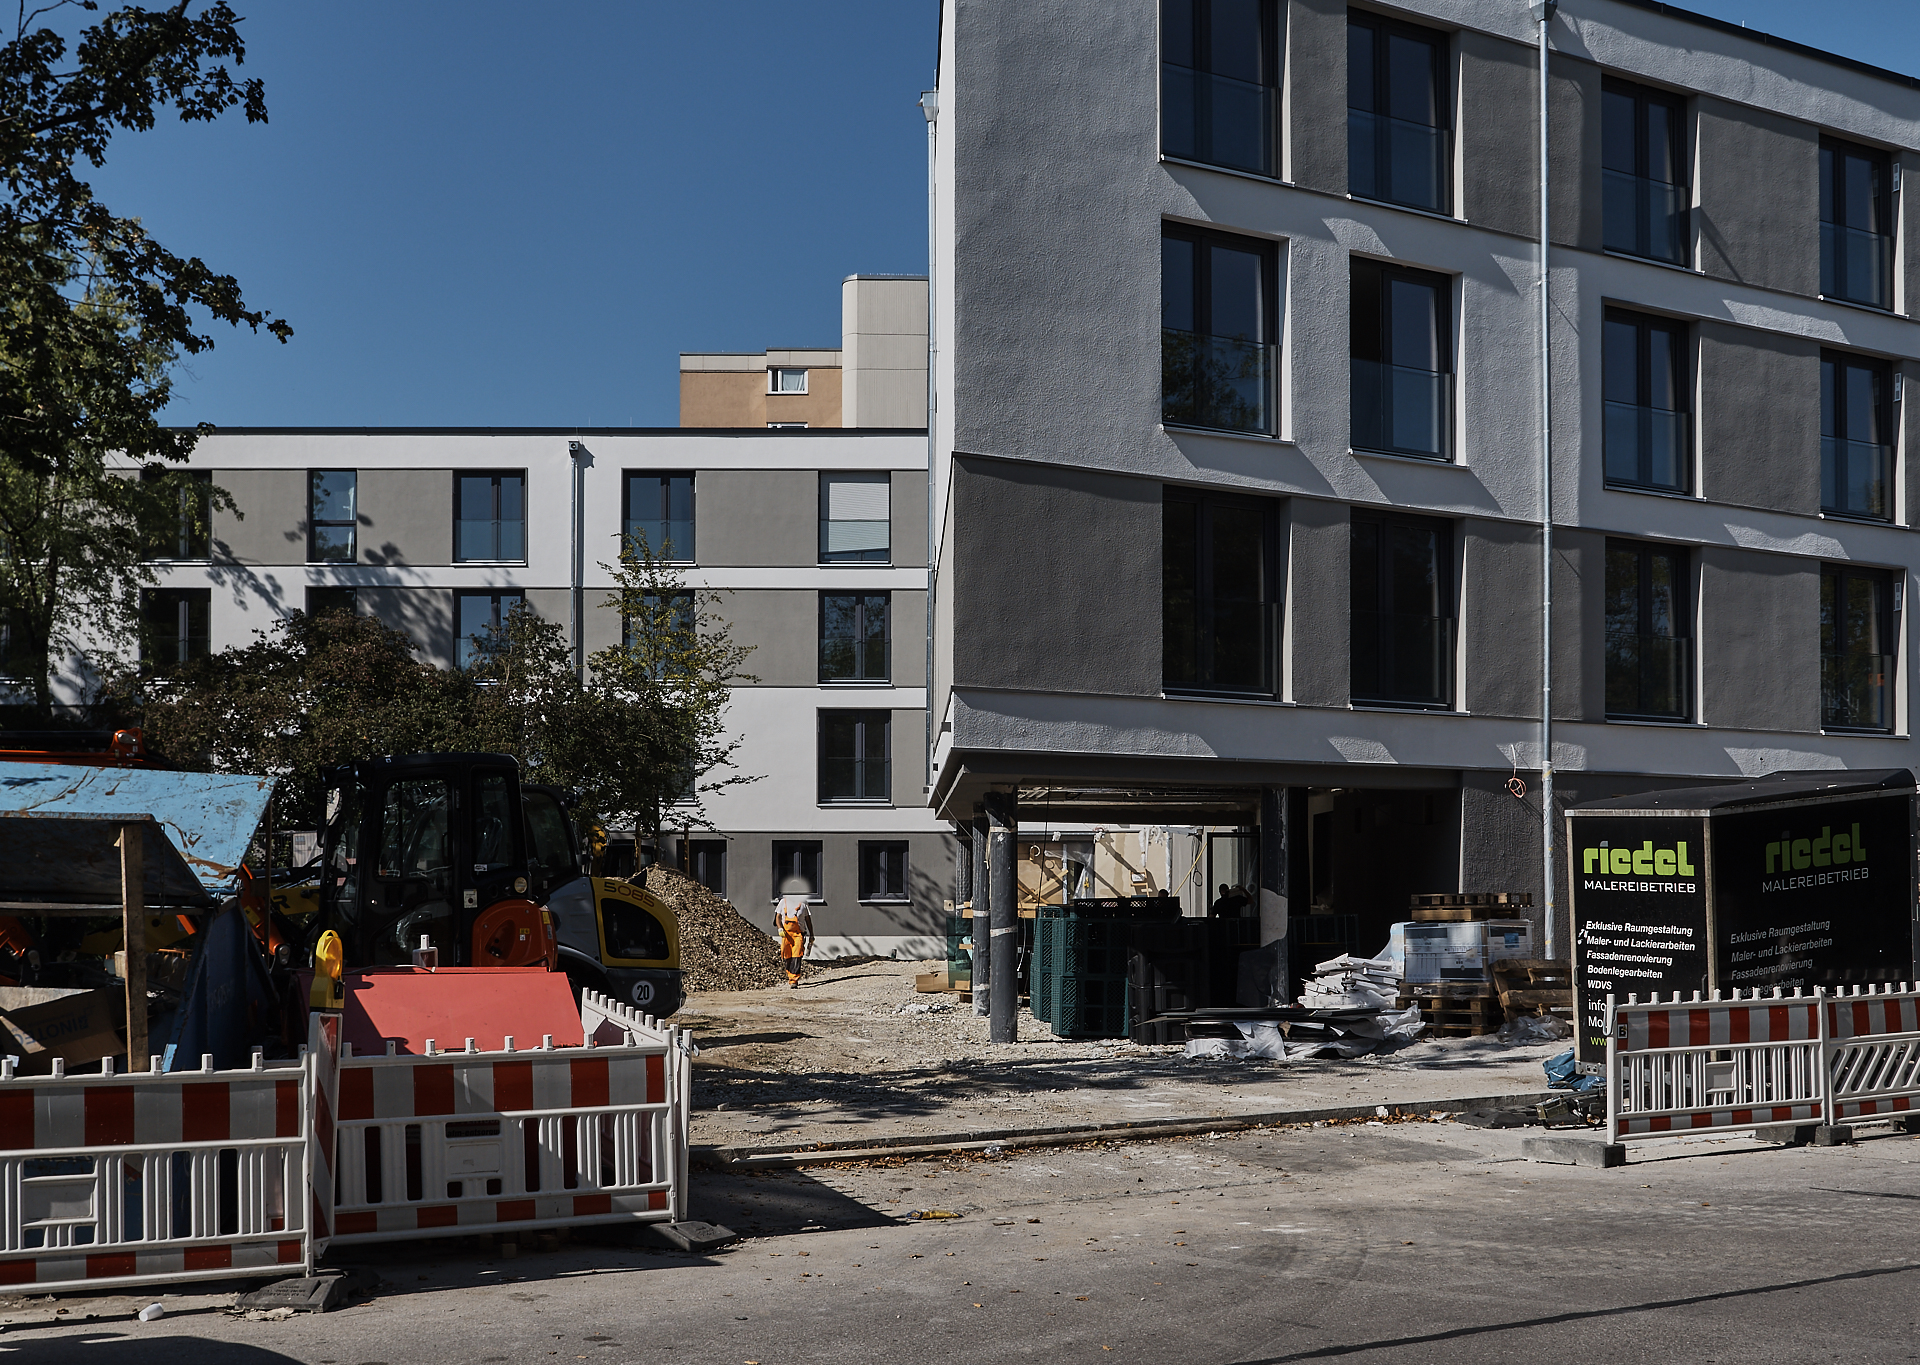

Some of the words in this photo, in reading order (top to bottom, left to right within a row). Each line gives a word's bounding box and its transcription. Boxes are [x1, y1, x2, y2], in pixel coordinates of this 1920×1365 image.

[1765, 822, 1867, 874] riedel
[1583, 840, 1695, 877] riedel
[1584, 880, 1696, 893] MALEREIBETRIEB
[1762, 867, 1870, 894] MALEREIBETRIEB
[604, 881, 655, 908] 5085
[1586, 920, 1623, 931] Exklusive
[1624, 922, 1693, 937] Raumgestaltung
[1730, 930, 1767, 944] Exklusive
[1768, 920, 1831, 936] Raumgestaltung
[1586, 936, 1612, 946] Maler-
[1613, 938, 1630, 947] und
[1631, 938, 1696, 951] Lackierarbeiten
[1731, 951, 1756, 963] Maler-
[1758, 946, 1773, 958] und
[1775, 937, 1833, 956] Lackierarbeiten
[1586, 950, 1673, 967] Fassadenrenovierung
[1587, 965, 1663, 979] Bodenlegearbeiten
[1731, 958, 1814, 981] Fassadenrenovierung
[637, 984, 650, 1001] 20
[1587, 979, 1613, 990] WDVS
